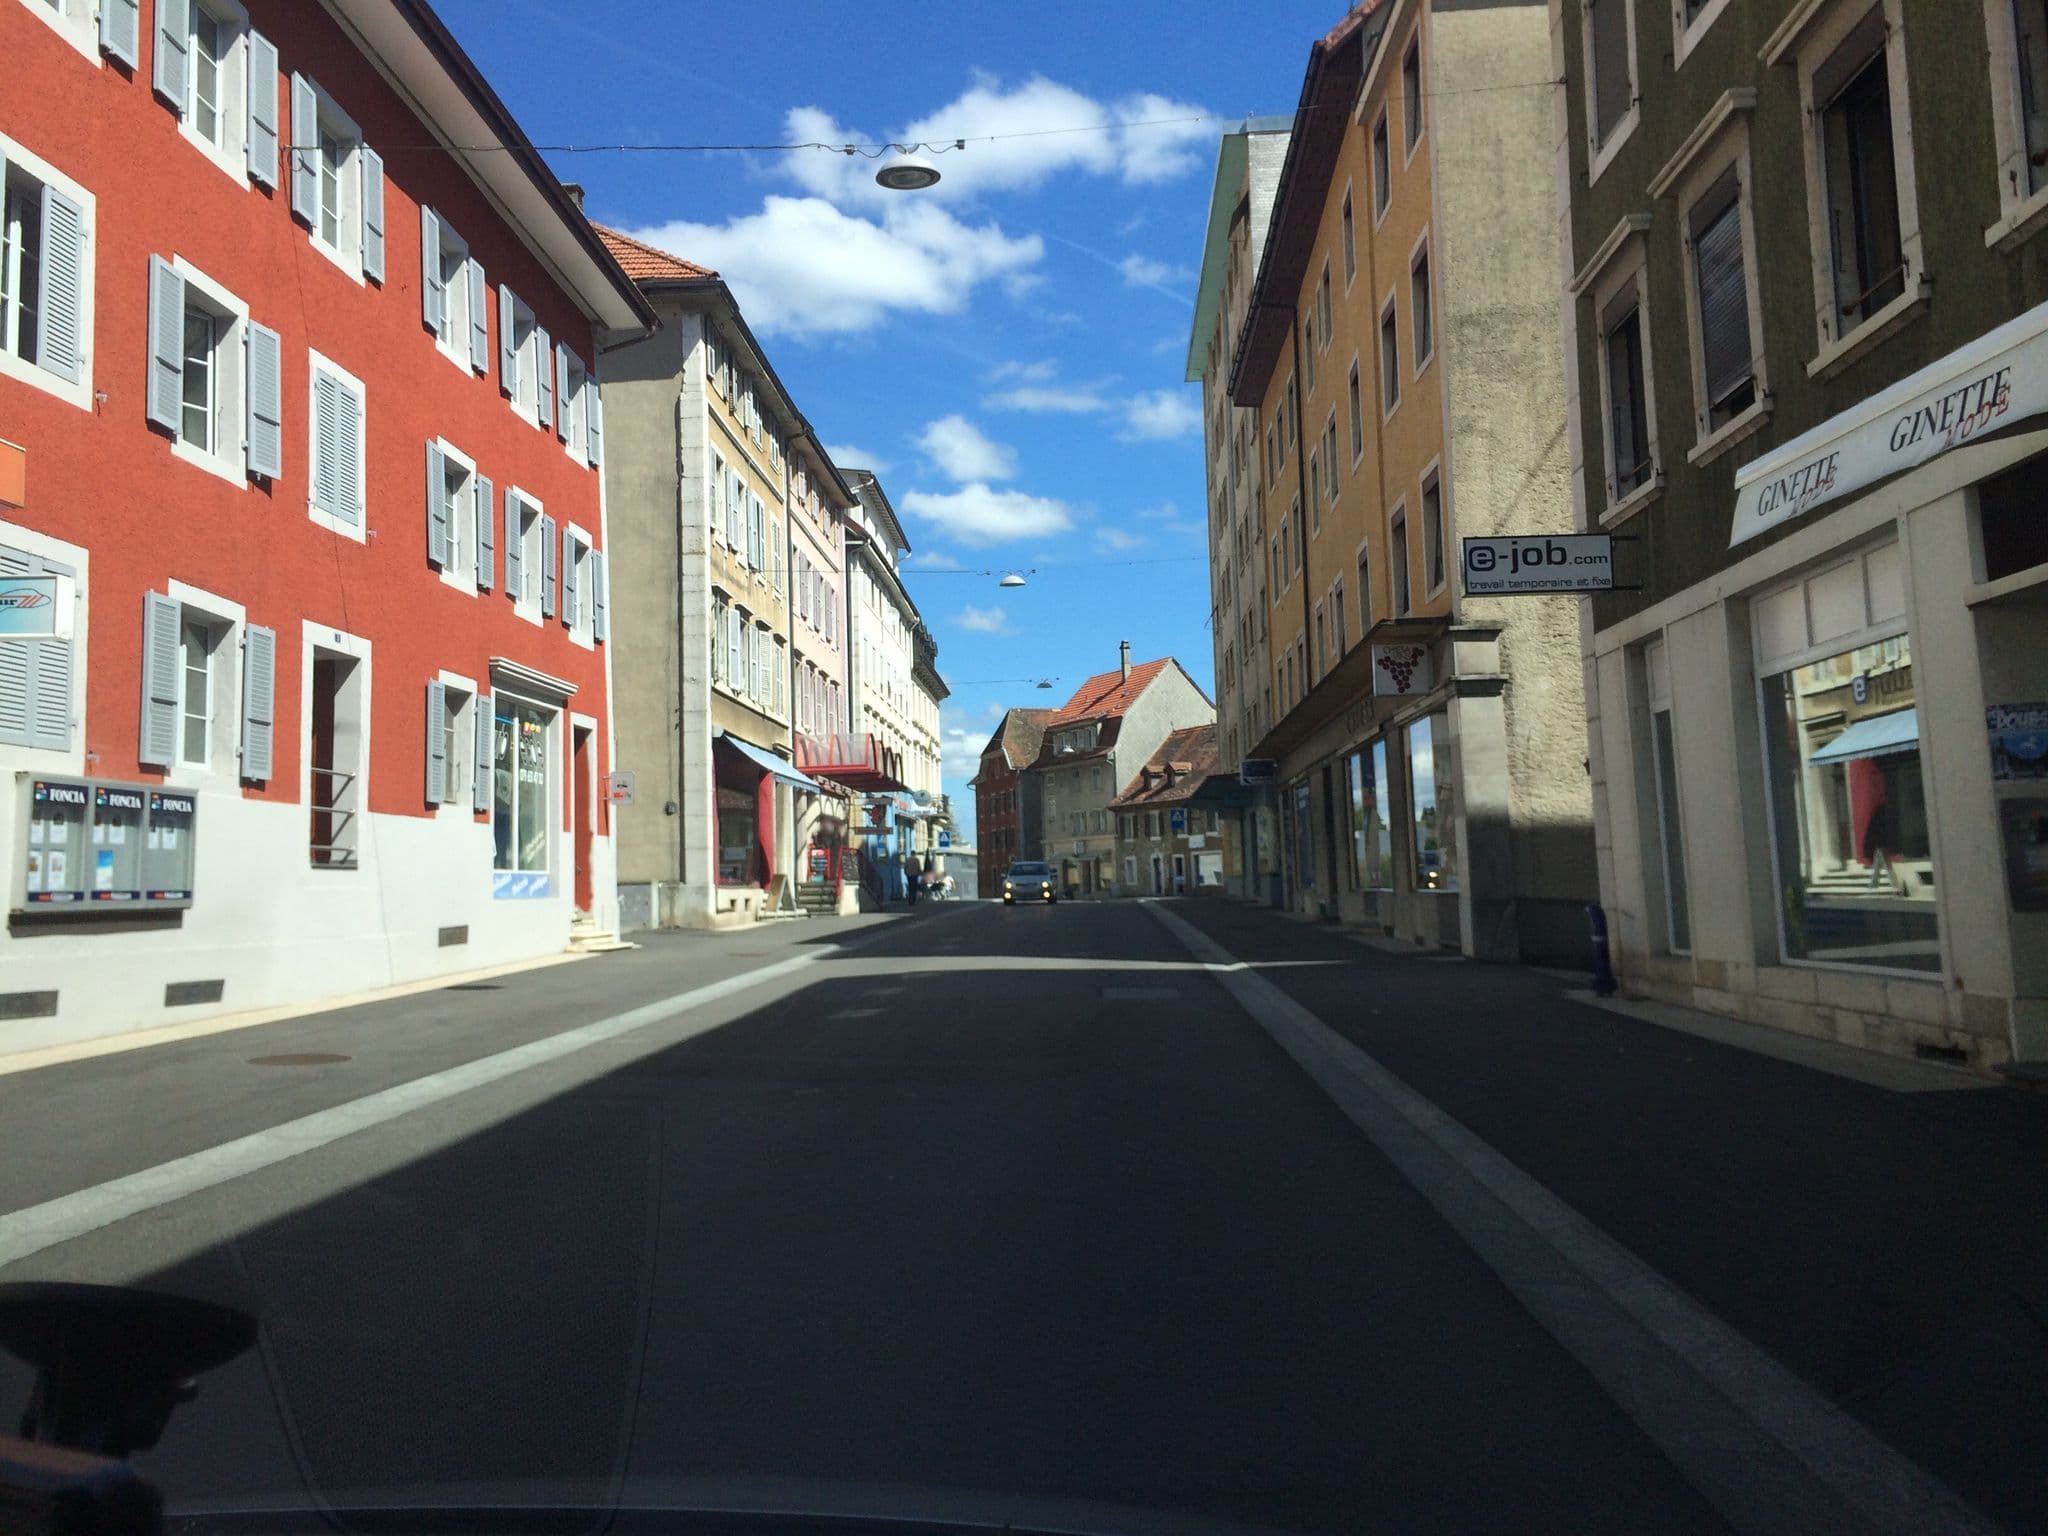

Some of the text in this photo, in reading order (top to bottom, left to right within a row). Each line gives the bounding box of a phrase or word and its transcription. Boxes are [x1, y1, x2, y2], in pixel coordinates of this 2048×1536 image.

[1890, 366, 2012, 452] GINETTE
[1758, 451, 1841, 517] GINETTE
[1469, 576, 1611, 590] travail temporaire et fixe
[49, 788, 86, 805] FONCIA
[109, 793, 142, 810] FONCIA
[162, 798, 194, 814] FONCIA
